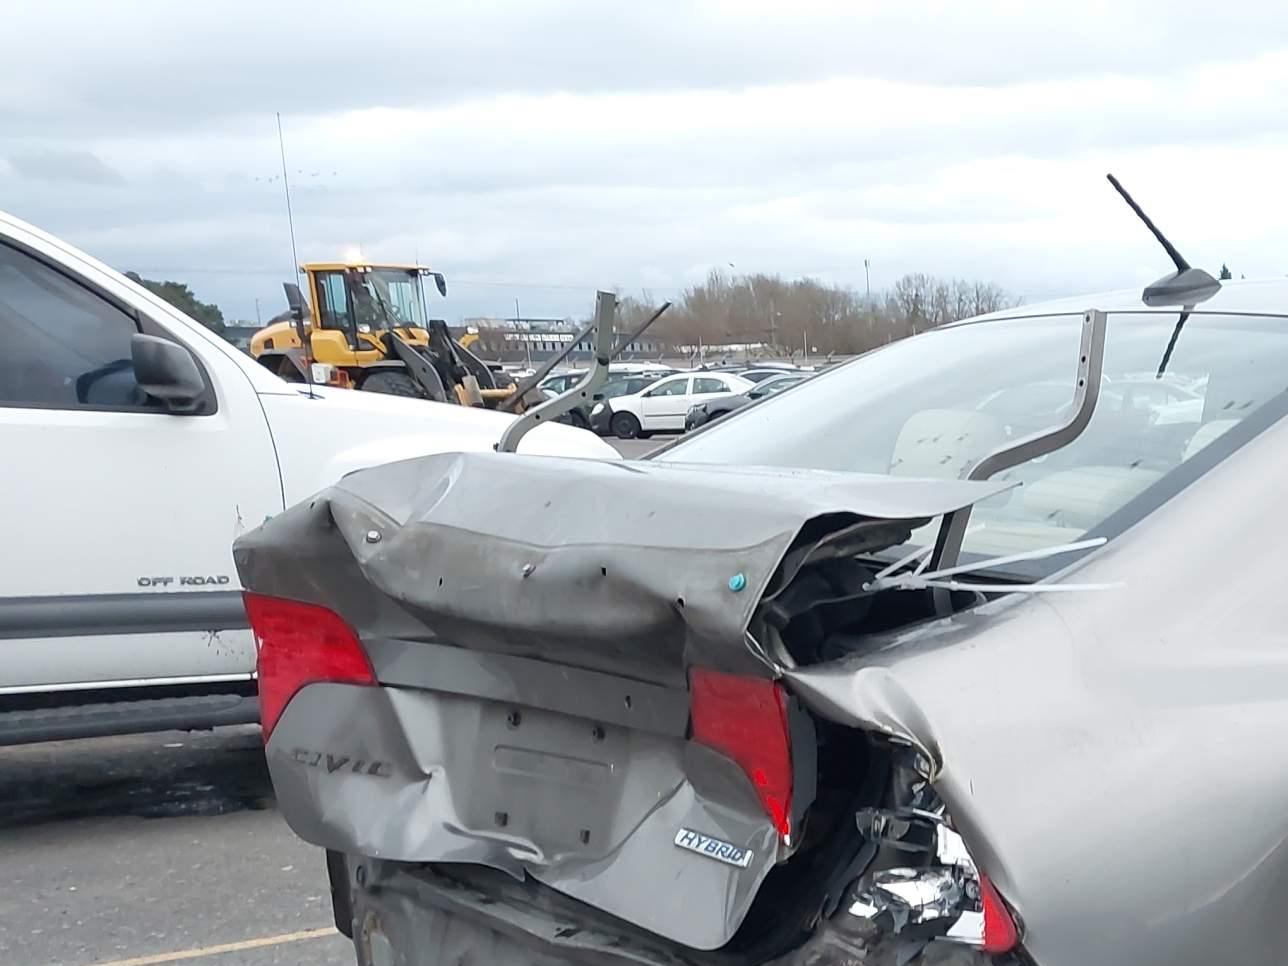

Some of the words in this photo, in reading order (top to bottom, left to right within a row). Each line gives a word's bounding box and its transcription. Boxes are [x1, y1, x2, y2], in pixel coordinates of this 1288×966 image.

[137, 576, 173, 587] OFF
[180, 575, 230, 586] ROAD
[292, 748, 391, 778] CIVIC
[680, 832, 745, 861] HYBRID
